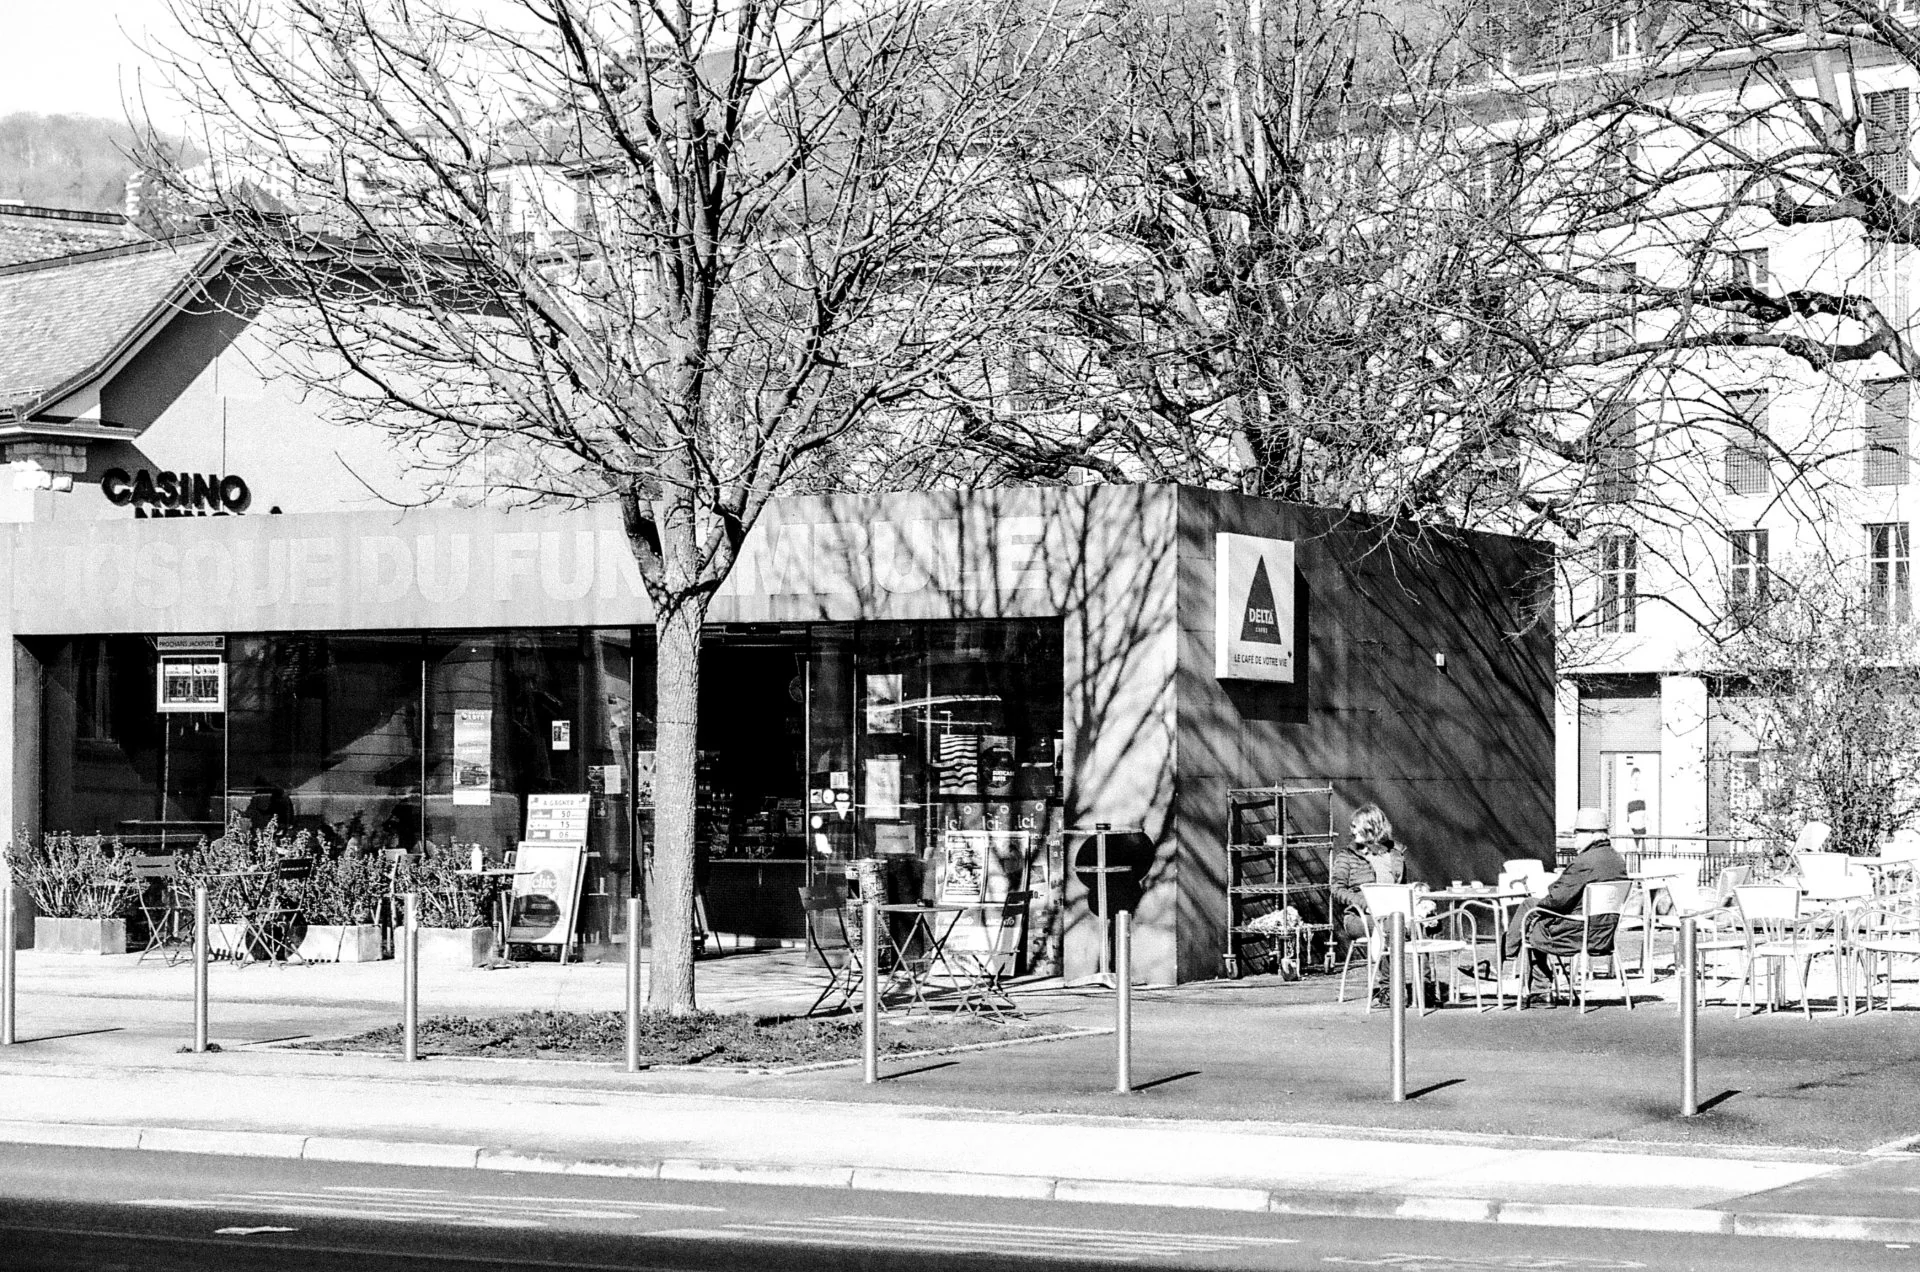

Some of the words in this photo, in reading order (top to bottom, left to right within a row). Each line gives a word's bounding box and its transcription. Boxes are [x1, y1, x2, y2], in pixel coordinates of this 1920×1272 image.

[101, 467, 251, 513] CASINO
[359, 533, 469, 602] DU
[494, 517, 1044, 601] FUNMBULE
[1248, 608, 1275, 625] DELTA
[1234, 653, 1241, 663] LE
[1241, 654, 1254, 664] CAFÉ
[1255, 655, 1262, 665] DE
[1263, 656, 1278, 666] VOTRE
[1279, 658, 1288, 667] VIE
